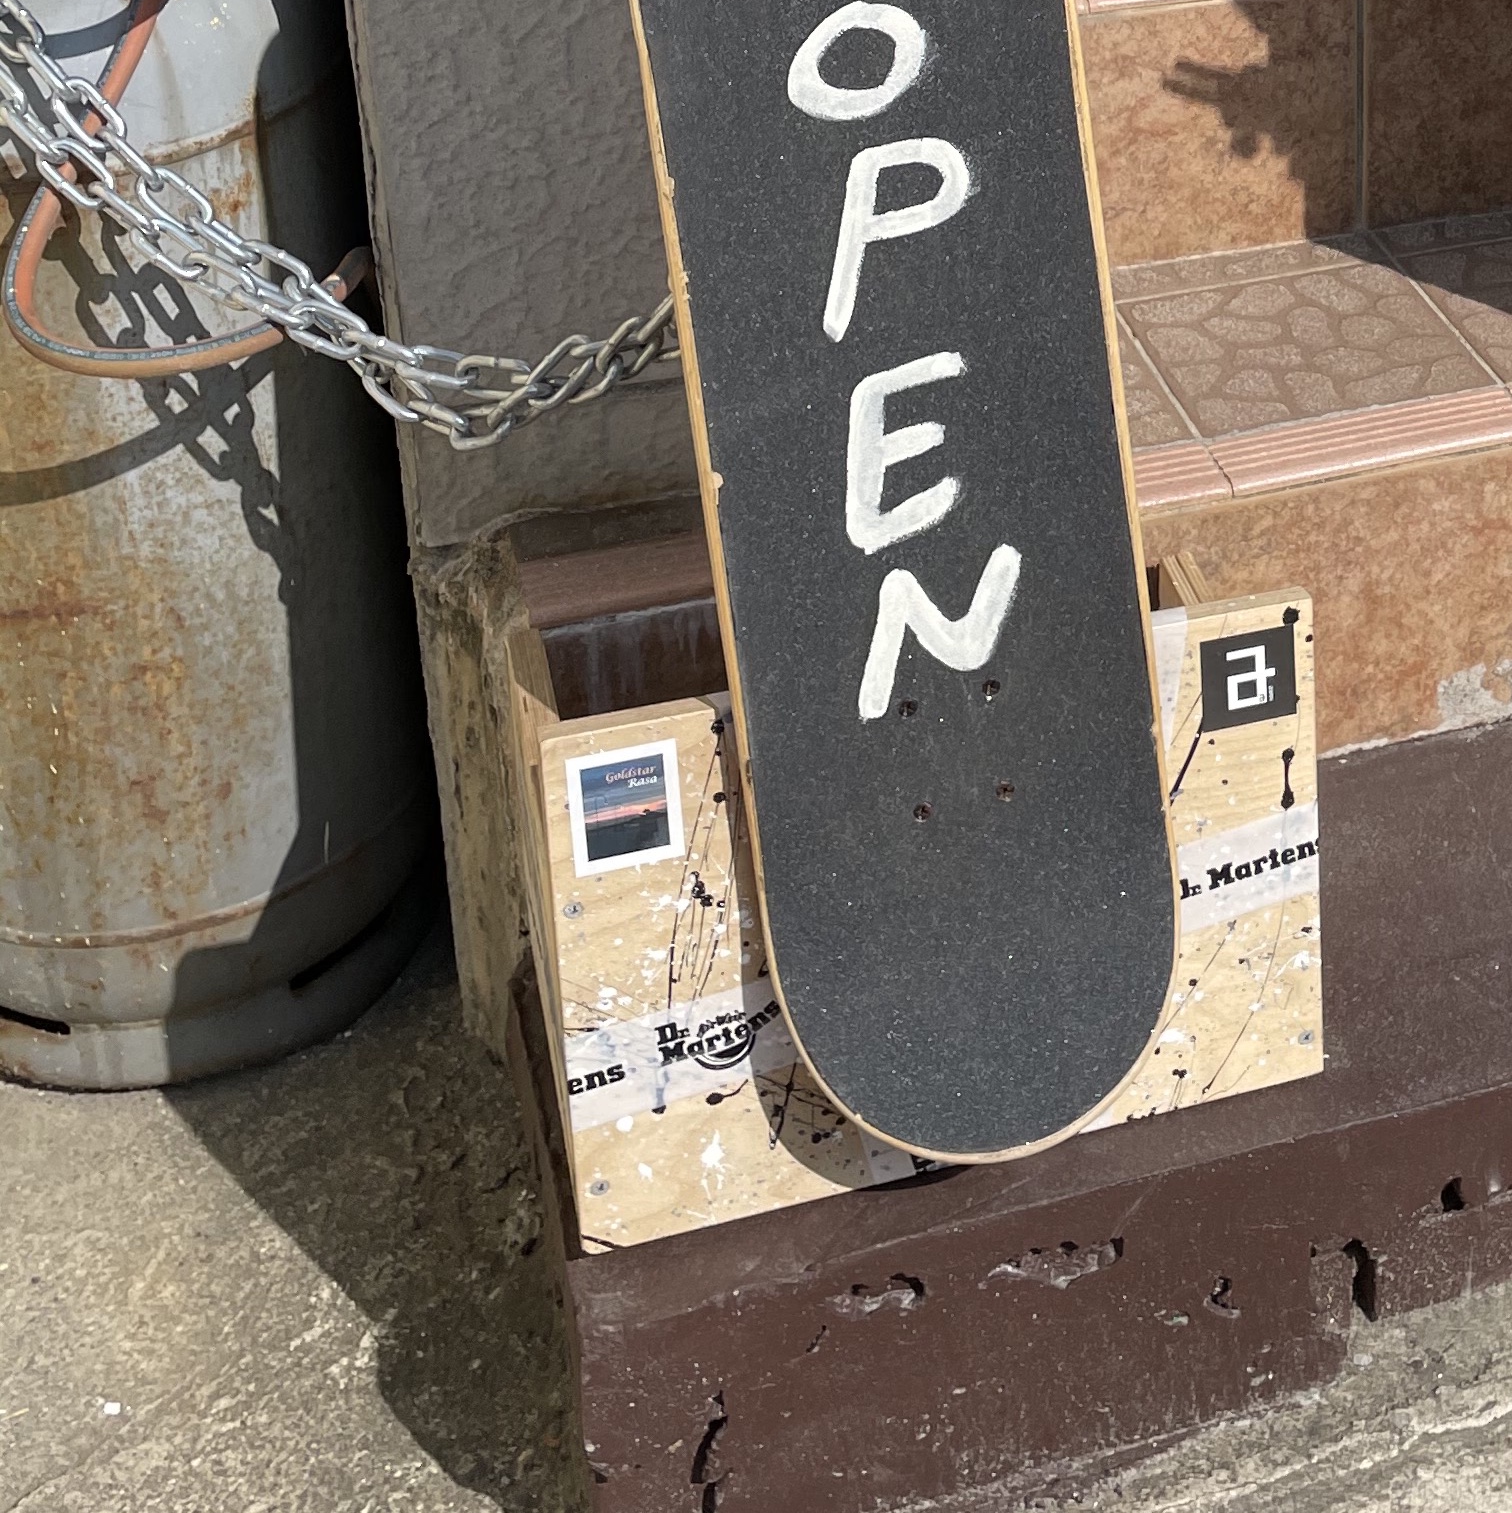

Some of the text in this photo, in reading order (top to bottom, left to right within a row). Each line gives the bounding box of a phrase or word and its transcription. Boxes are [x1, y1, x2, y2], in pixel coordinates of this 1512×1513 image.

[788, 1, 1023, 722] OPEN
[1206, 837, 1320, 891] Marten
[658, 1000, 781, 1067] Martens
